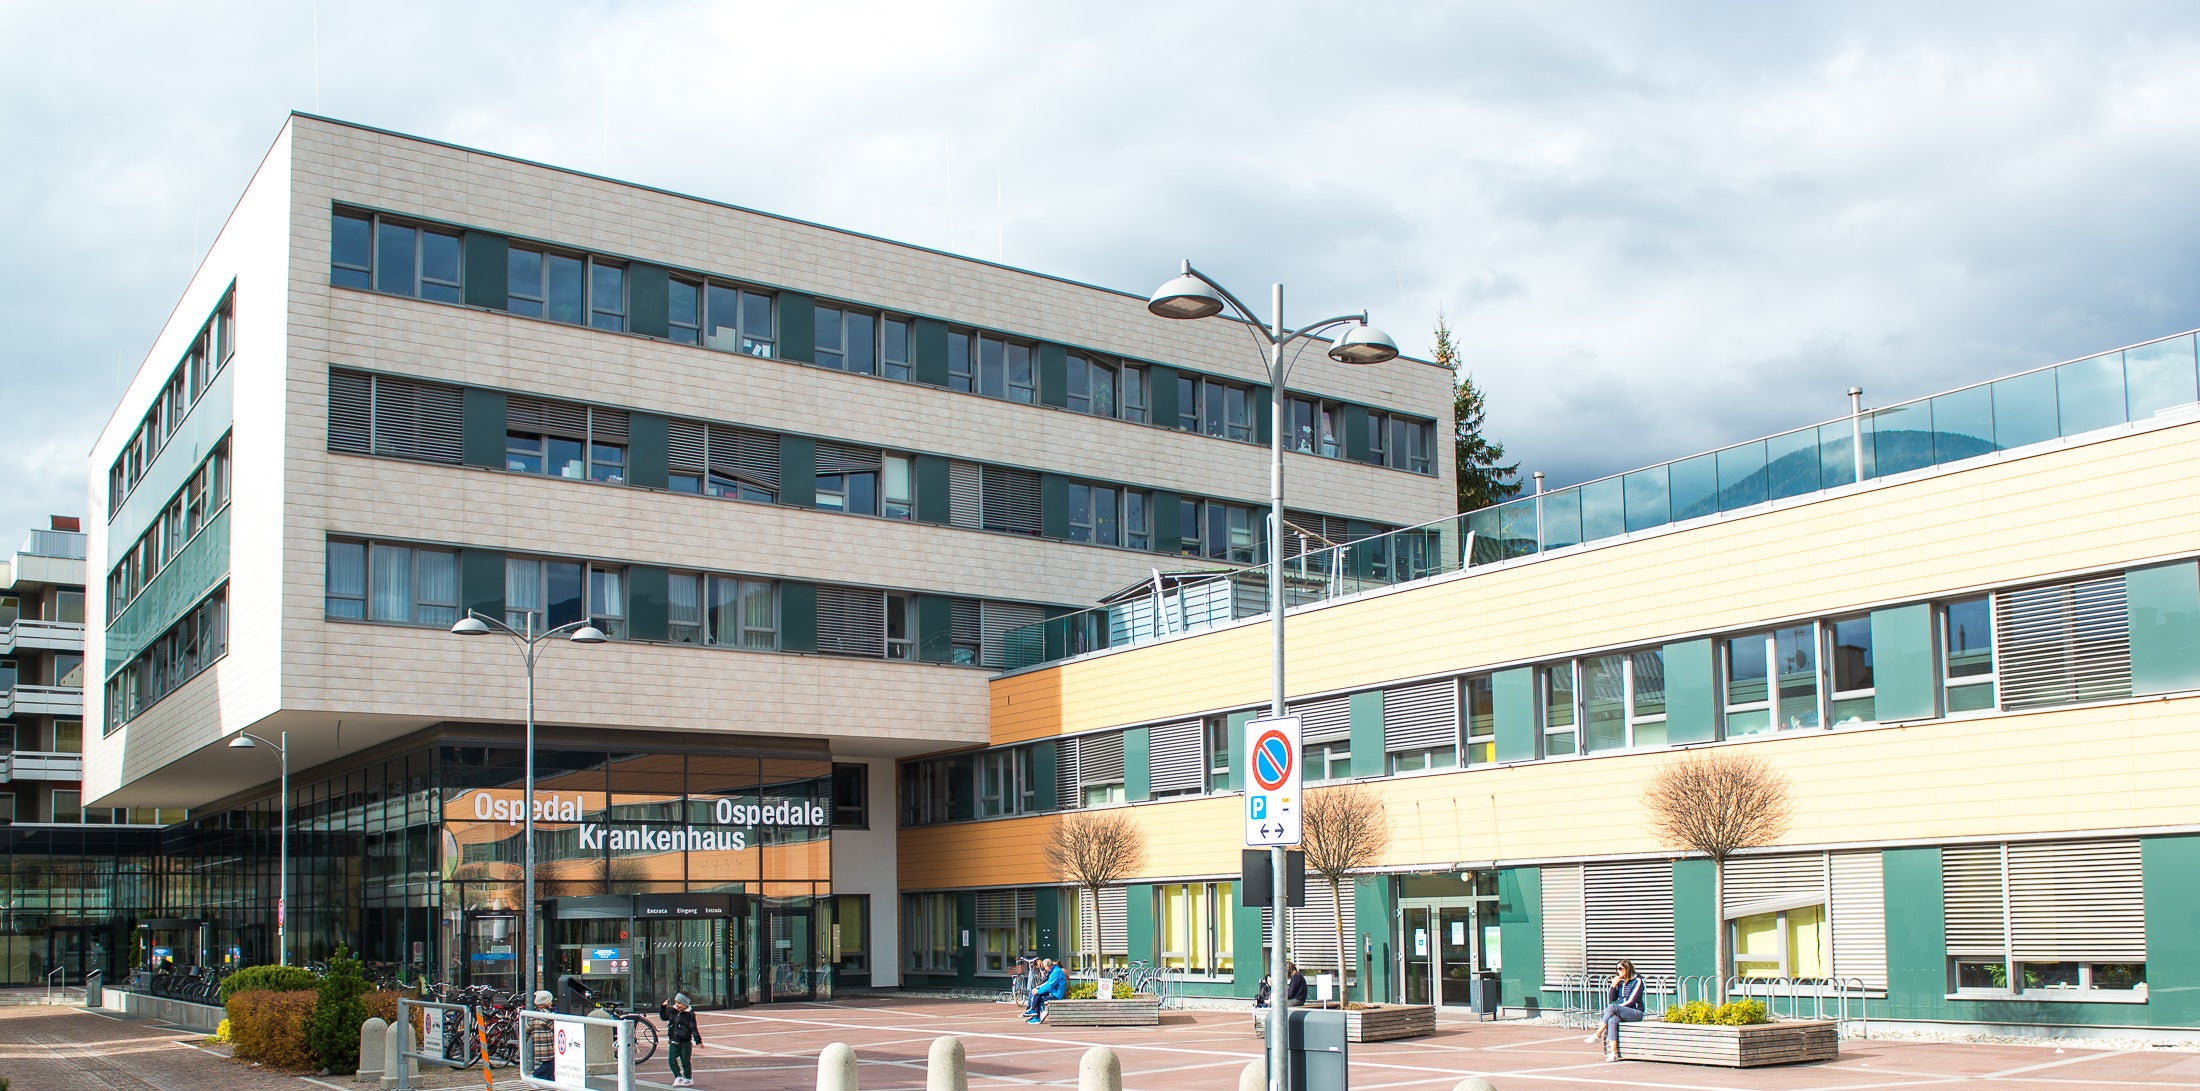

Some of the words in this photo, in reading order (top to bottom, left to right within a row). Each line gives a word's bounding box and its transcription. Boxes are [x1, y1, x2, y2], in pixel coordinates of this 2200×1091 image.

[474, 792, 583, 826] Ospedal
[716, 799, 824, 829] Ospedale
[1253, 798, 1264, 818] P
[579, 824, 745, 851] Krankenhaus
[676, 907, 698, 915] Eingang
